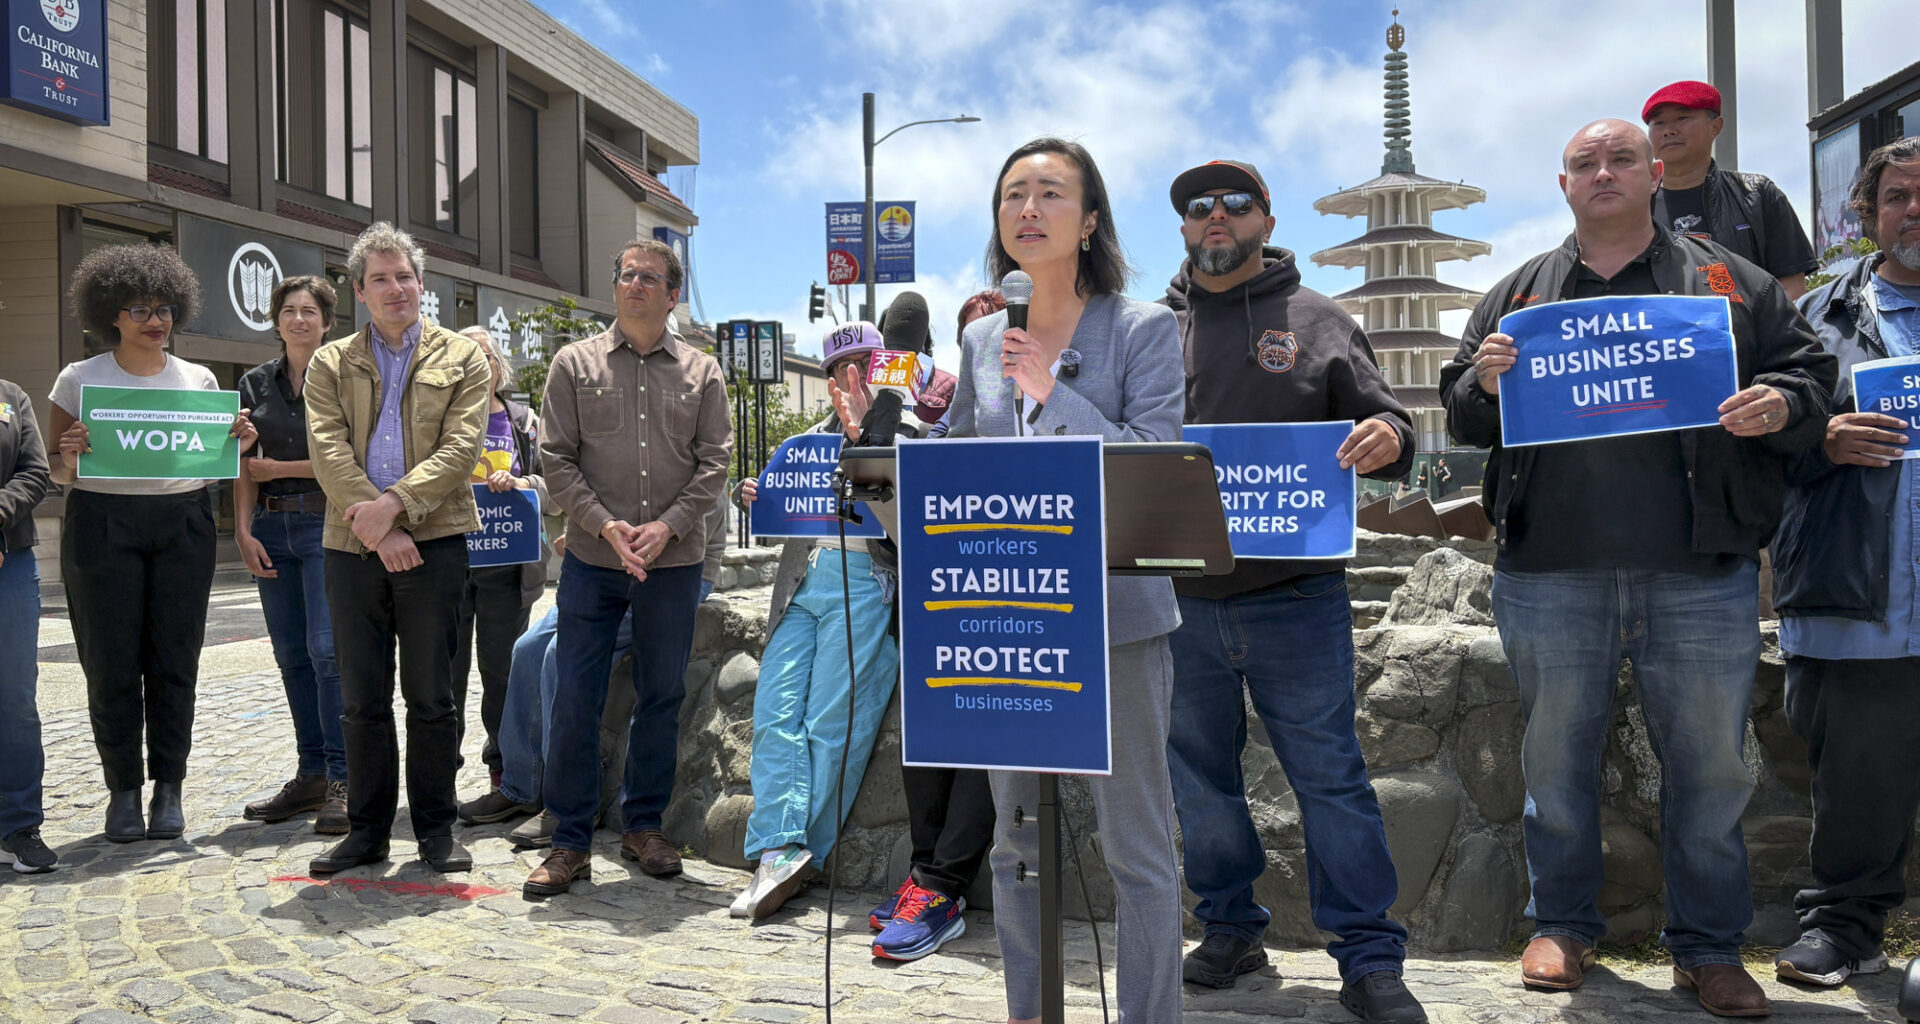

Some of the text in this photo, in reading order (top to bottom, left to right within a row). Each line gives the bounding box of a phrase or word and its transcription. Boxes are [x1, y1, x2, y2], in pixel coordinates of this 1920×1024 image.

[17, 25, 99, 68] CALIFORNIA
[41, 51, 79, 79] BANK
[43, 86, 78, 106] TRUST
[830, 213, 863, 226] 日本町
[1561, 312, 1653, 341] SMALL
[761, 349, 772, 368] つる
[874, 352, 910, 367] 天下
[1530, 337, 1696, 379] BUSINESSES
[871, 368, 907, 384] 衛視
[1572, 376, 1655, 407] UNITE
[115, 429, 205, 452] WOPA
[483, 438, 496, 447] Do
[785, 447, 840, 463] SMALL
[765, 472, 832, 488] BUSINES
[1214, 464, 1308, 484] ONOMIC
[785, 497, 836, 513] UNITE
[924, 494, 1075, 520] EMPOWER
[1220, 489, 1326, 510] RITY FOR
[477, 505, 512, 519] OMIC
[494, 521, 523, 534] FOR
[1228, 515, 1299, 533] RKERS
[466, 537, 509, 551] RKERS
[958, 537, 1038, 555] workers
[931, 567, 1070, 594] STABILIZE
[959, 616, 1044, 634] corridors
[935, 646, 1070, 674] PROTECT
[955, 693, 1053, 712] businesses
